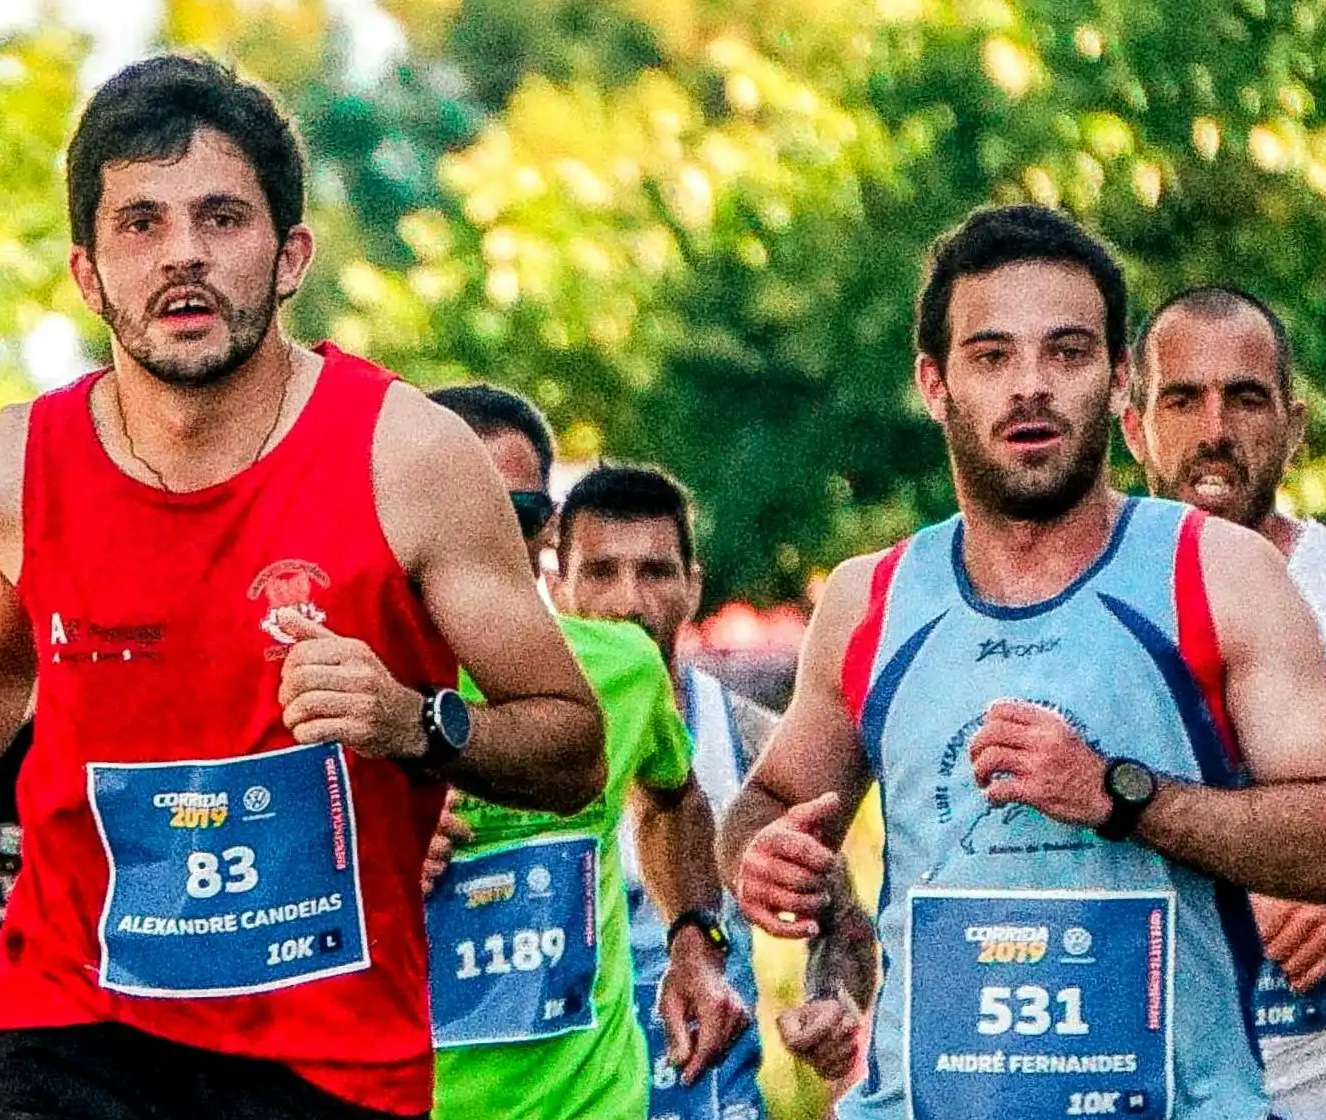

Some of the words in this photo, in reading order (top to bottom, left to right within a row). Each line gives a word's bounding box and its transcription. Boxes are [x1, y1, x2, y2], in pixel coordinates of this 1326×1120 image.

[152, 791, 229, 809] CORRIDA
[169, 806, 229, 828] 2019
[186, 845, 259, 899] 83
[118, 910, 237, 936] ALEXANDRE
[240, 893, 342, 929] CANDEIAS
[266, 935, 314, 966] 10K
[455, 926, 566, 980] 1189
[977, 940, 1049, 964] 2019
[976, 984, 1090, 1036] 531
[935, 1051, 1006, 1073] ANDRÉ
[1009, 1053, 1138, 1074] FERNANDES
[1066, 1090, 1121, 1115] 10K
